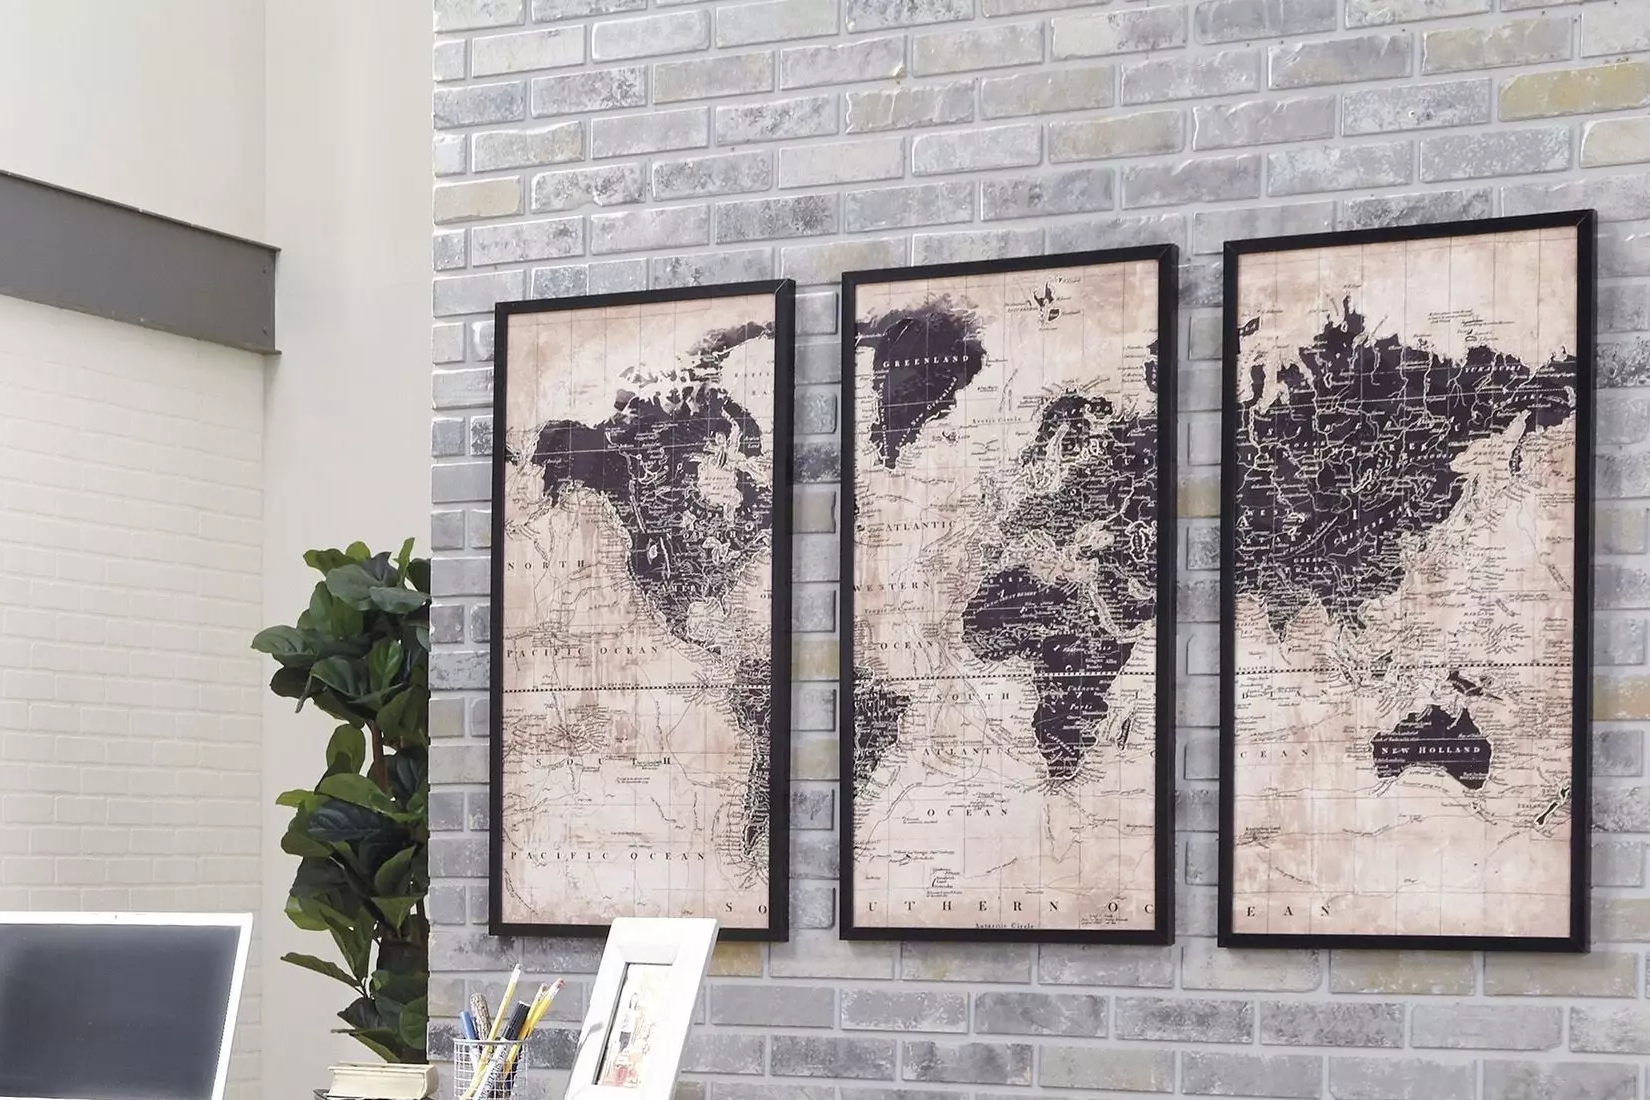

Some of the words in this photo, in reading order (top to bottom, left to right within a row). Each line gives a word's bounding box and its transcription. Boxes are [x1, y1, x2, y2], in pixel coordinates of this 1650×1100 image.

[882, 355, 970, 368] GREENLAND
[885, 521, 956, 532] ATLANTIC
[507, 559, 585, 571] NORTH
[880, 640, 933, 650] OCEAN
[506, 646, 586, 658] PACIFIC
[599, 645, 659, 656] OCEAN
[936, 692, 1010, 701] SOUTH
[923, 747, 1013, 756] ATLANTIC
[1240, 749, 1309, 759] CEAN
[1381, 746, 1410, 755] NEW
[1418, 746, 1481, 755] HOLLAND
[536, 757, 671, 767] SOUTH
[927, 808, 1008, 817] OCEAN
[510, 851, 610, 861] PACIFIC
[630, 851, 705, 862] OCEAN
[725, 901, 768, 915] SO
[868, 900, 1059, 913] UTHERN
[1245, 904, 1330, 918] EAN
